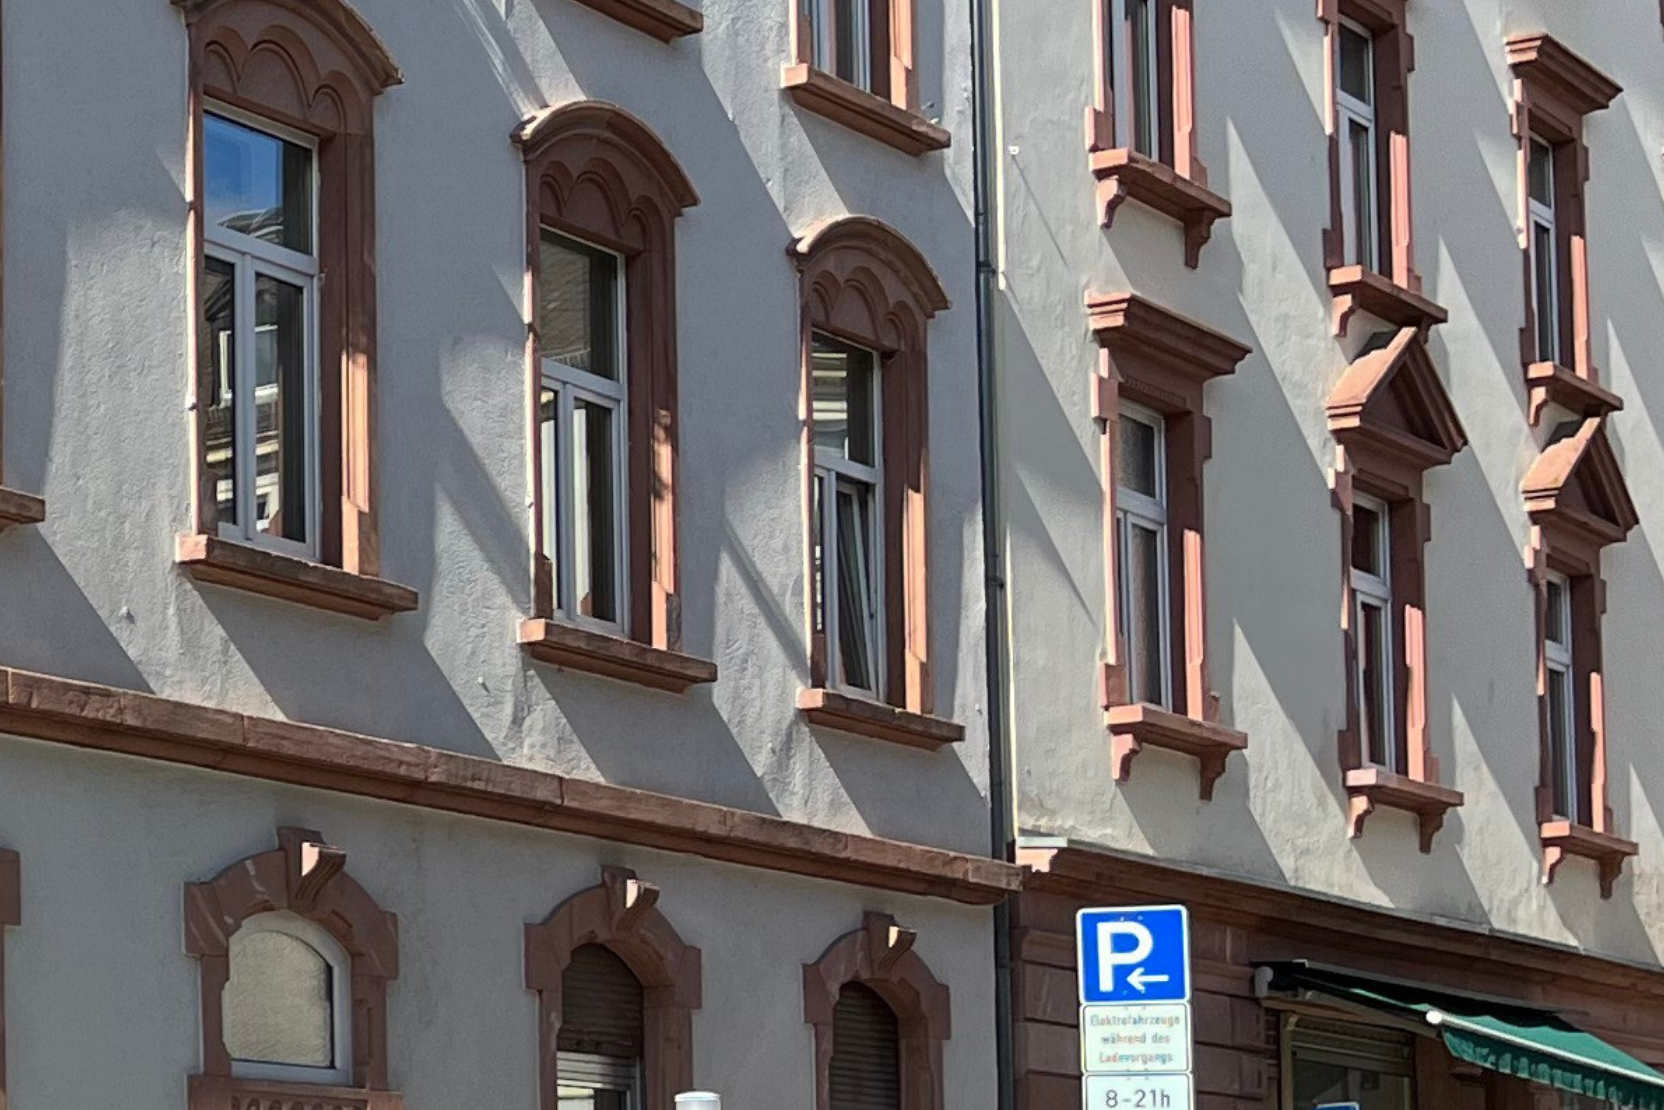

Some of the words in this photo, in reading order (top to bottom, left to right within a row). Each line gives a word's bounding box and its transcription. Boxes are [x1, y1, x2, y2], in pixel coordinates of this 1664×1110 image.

[1097, 921, 1154, 992] P
[1089, 1013, 1181, 1027] Elektrofahrzeuge
[1101, 1032, 1147, 1044] während
[1099, 1051, 1173, 1065] Ladevorgangs
